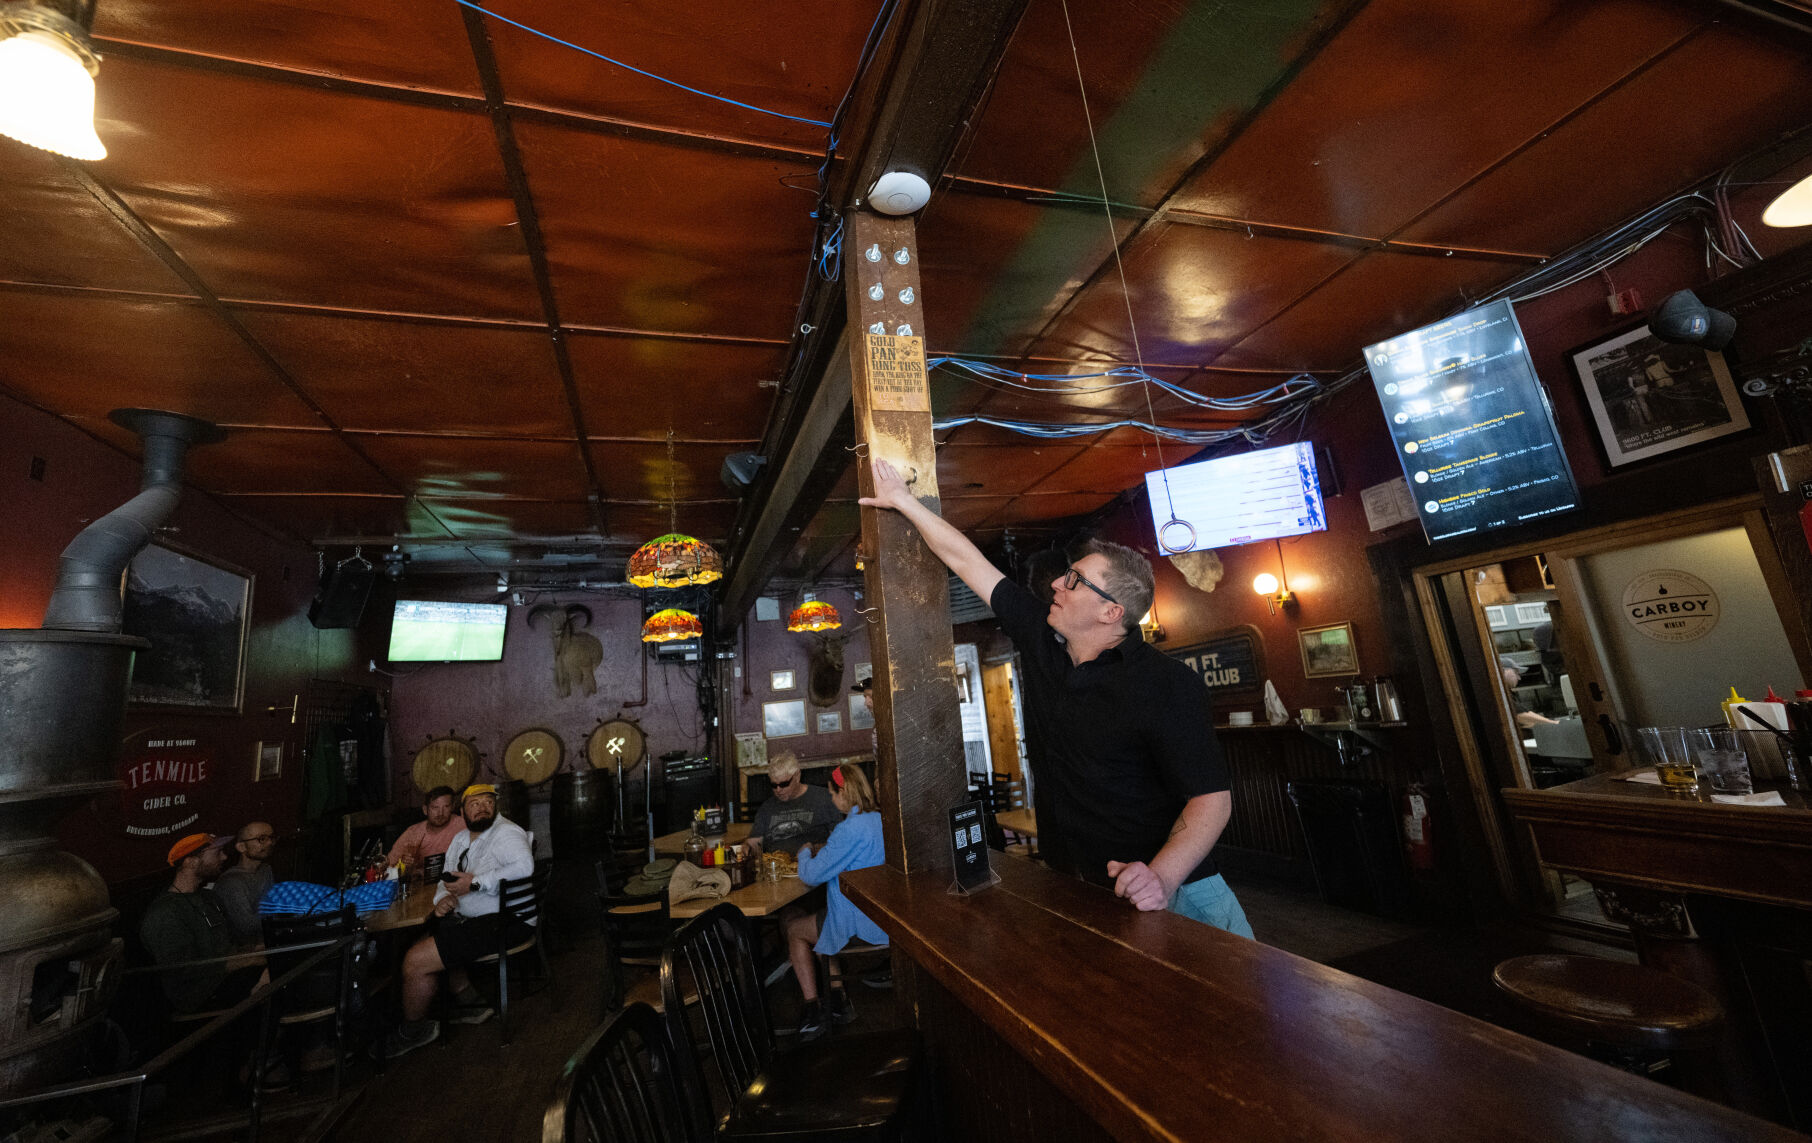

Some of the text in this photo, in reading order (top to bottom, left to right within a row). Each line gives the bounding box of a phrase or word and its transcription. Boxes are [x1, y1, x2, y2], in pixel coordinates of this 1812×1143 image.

[870, 336, 895, 347] GOLD
[872, 347, 895, 360] PAN
[872, 360, 922, 371] RING TOSS
[1631, 600, 1708, 618] CARBOY
[1664, 621, 1686, 629] WINERY
[1201, 652, 1221, 670] FT.
[1204, 667, 1240, 687] CLUB
[128, 760, 207, 789] TENMILE
[143, 794, 187, 810] CIDER CO.
[171, 813, 199, 832] COLORADO
